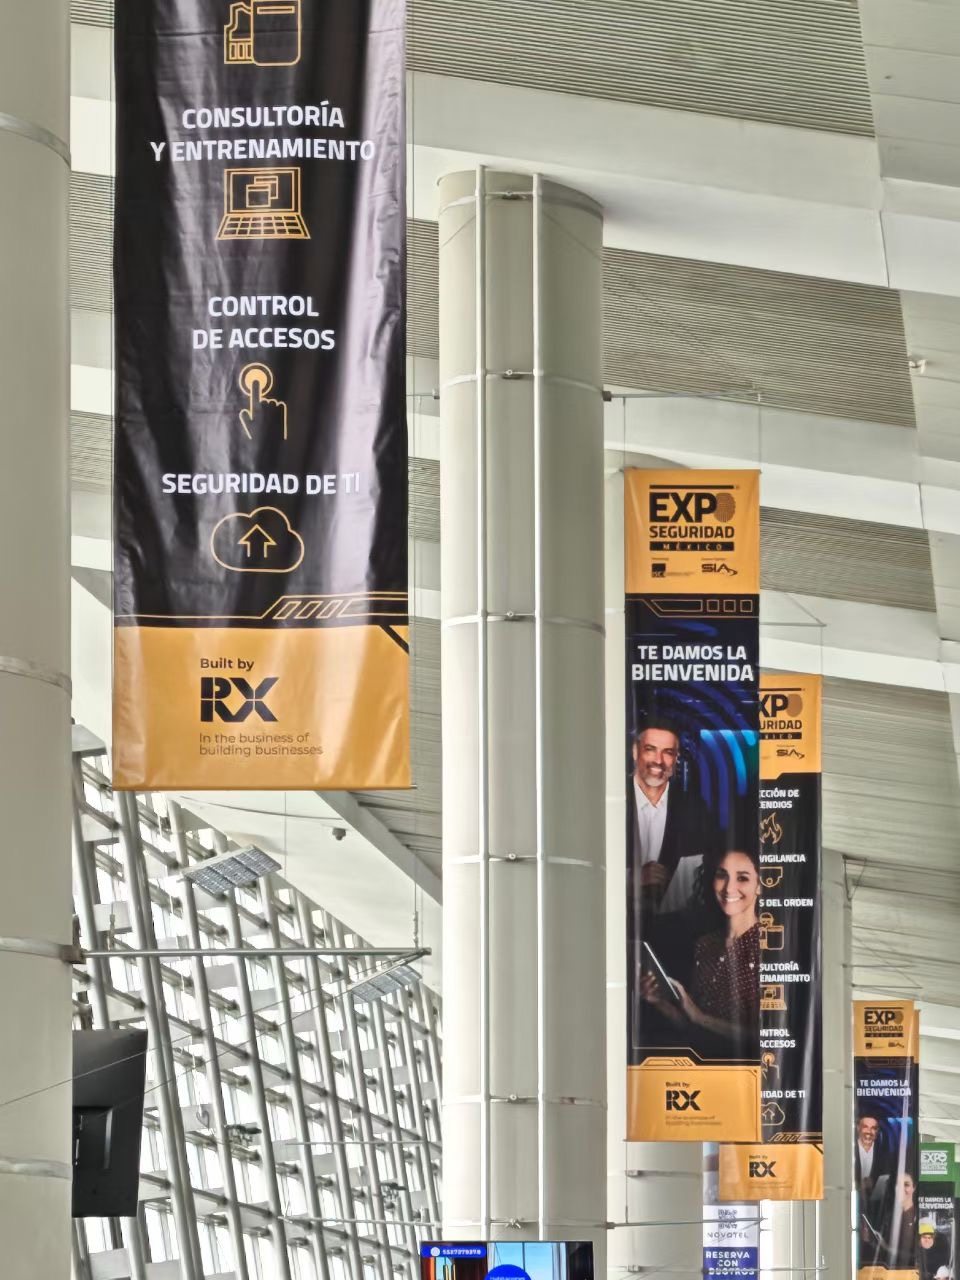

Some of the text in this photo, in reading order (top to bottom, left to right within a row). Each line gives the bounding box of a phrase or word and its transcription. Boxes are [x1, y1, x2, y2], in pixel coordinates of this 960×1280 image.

[182, 101, 344, 129] CONSULTORÍA
[151, 138, 376, 161] Y ENTRENAMIENTO
[208, 296, 319, 317] CONTROL
[192, 328, 335, 350] DE ACCESOS
[162, 472, 361, 495] SEGURIDAD DE TI
[649, 492, 736, 523] EXPO
[649, 526, 735, 538] SEGURIDAD
[663, 542, 722, 550] MÉXICO
[637, 645, 747, 661] TE DAMOS LA
[200, 658, 254, 672] Built by
[631, 664, 754, 682] BIENVENIDA
[201, 677, 279, 722] RX
[200, 733, 309, 743] In the business of
[200, 745, 323, 757] building businesses
[788, 790, 799, 798] DE
[766, 899, 782, 907] DEL
[784, 899, 814, 907] ORDEN
[798, 1090, 806, 1098] TI
[856, 1088, 911, 1096] BIENVENIDA
[666, 1090, 701, 1111] RX
[749, 1162, 777, 1178] RX
[705, 1251, 750, 1259] RESERVA
